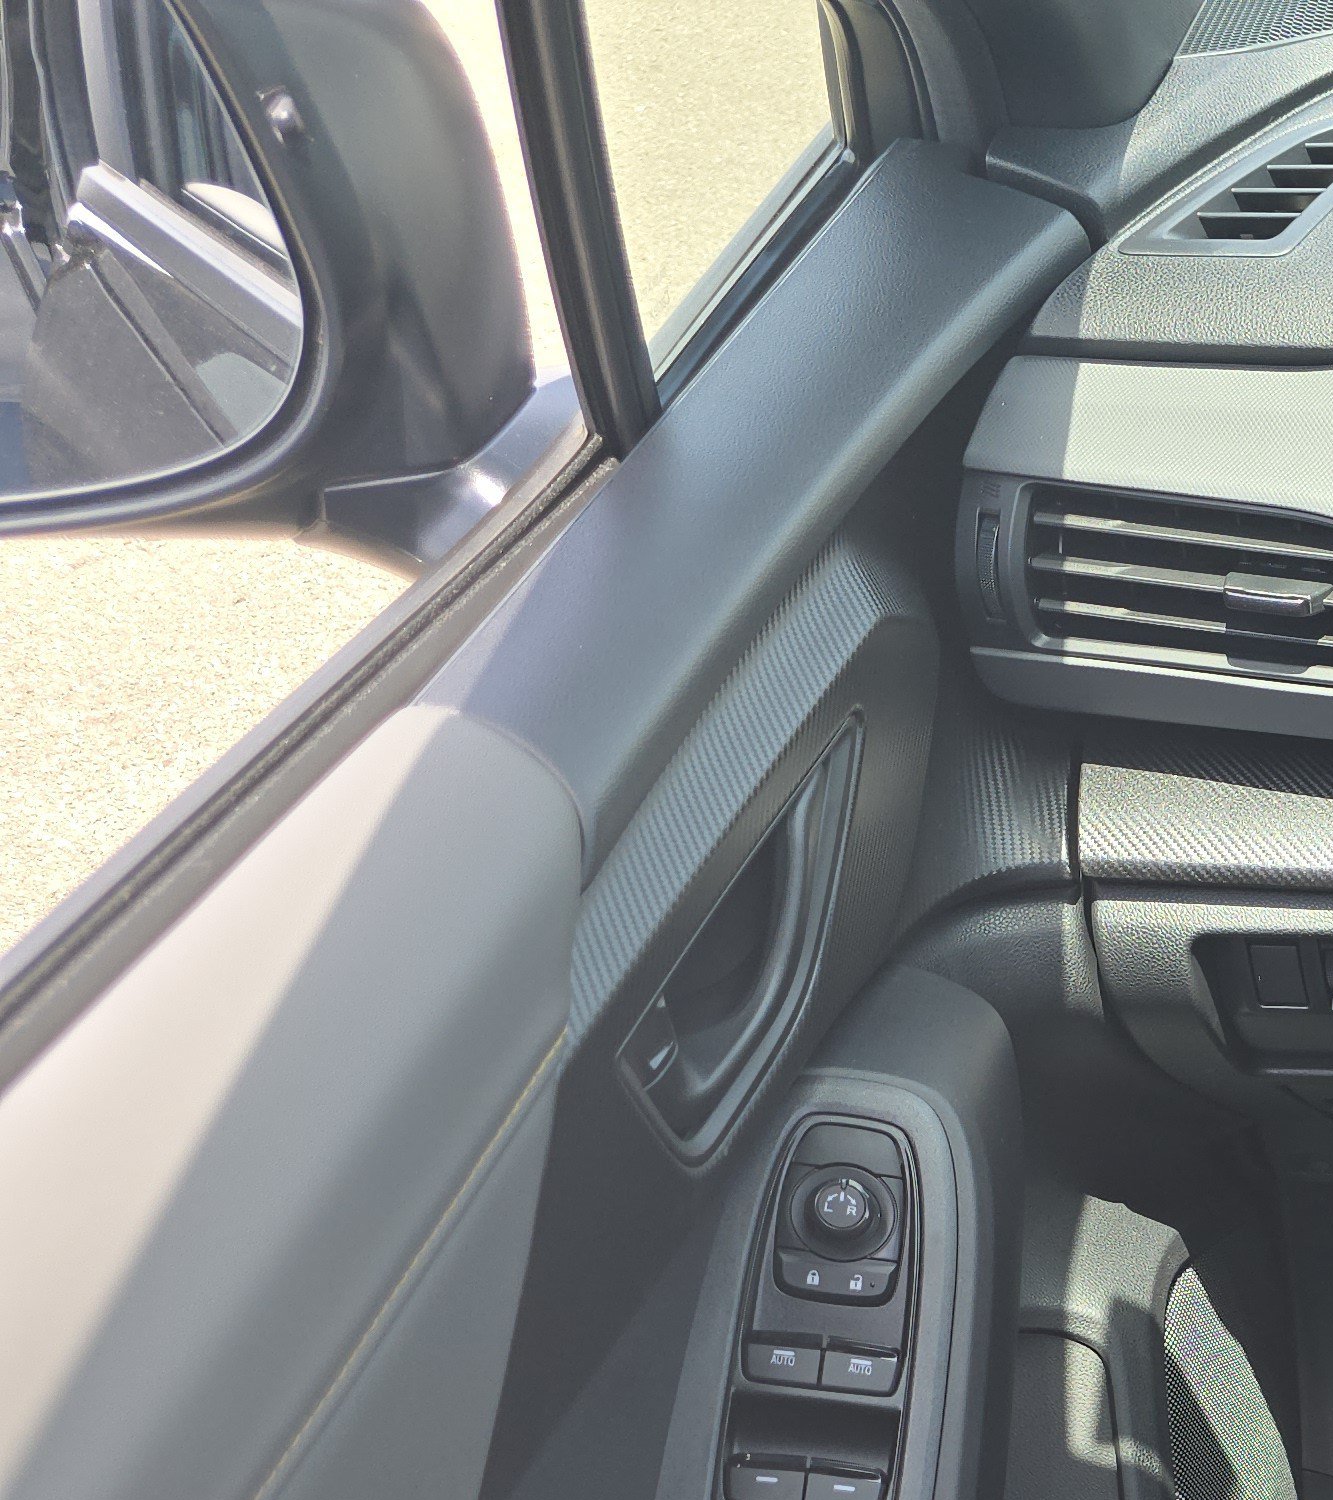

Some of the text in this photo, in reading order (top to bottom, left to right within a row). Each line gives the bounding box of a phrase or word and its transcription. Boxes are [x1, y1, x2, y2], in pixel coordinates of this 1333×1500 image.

[824, 1201, 833, 1212] L
[846, 1205, 857, 1216] R
[770, 1354, 796, 1367] AUTO
[848, 1363, 872, 1376] AUTO
